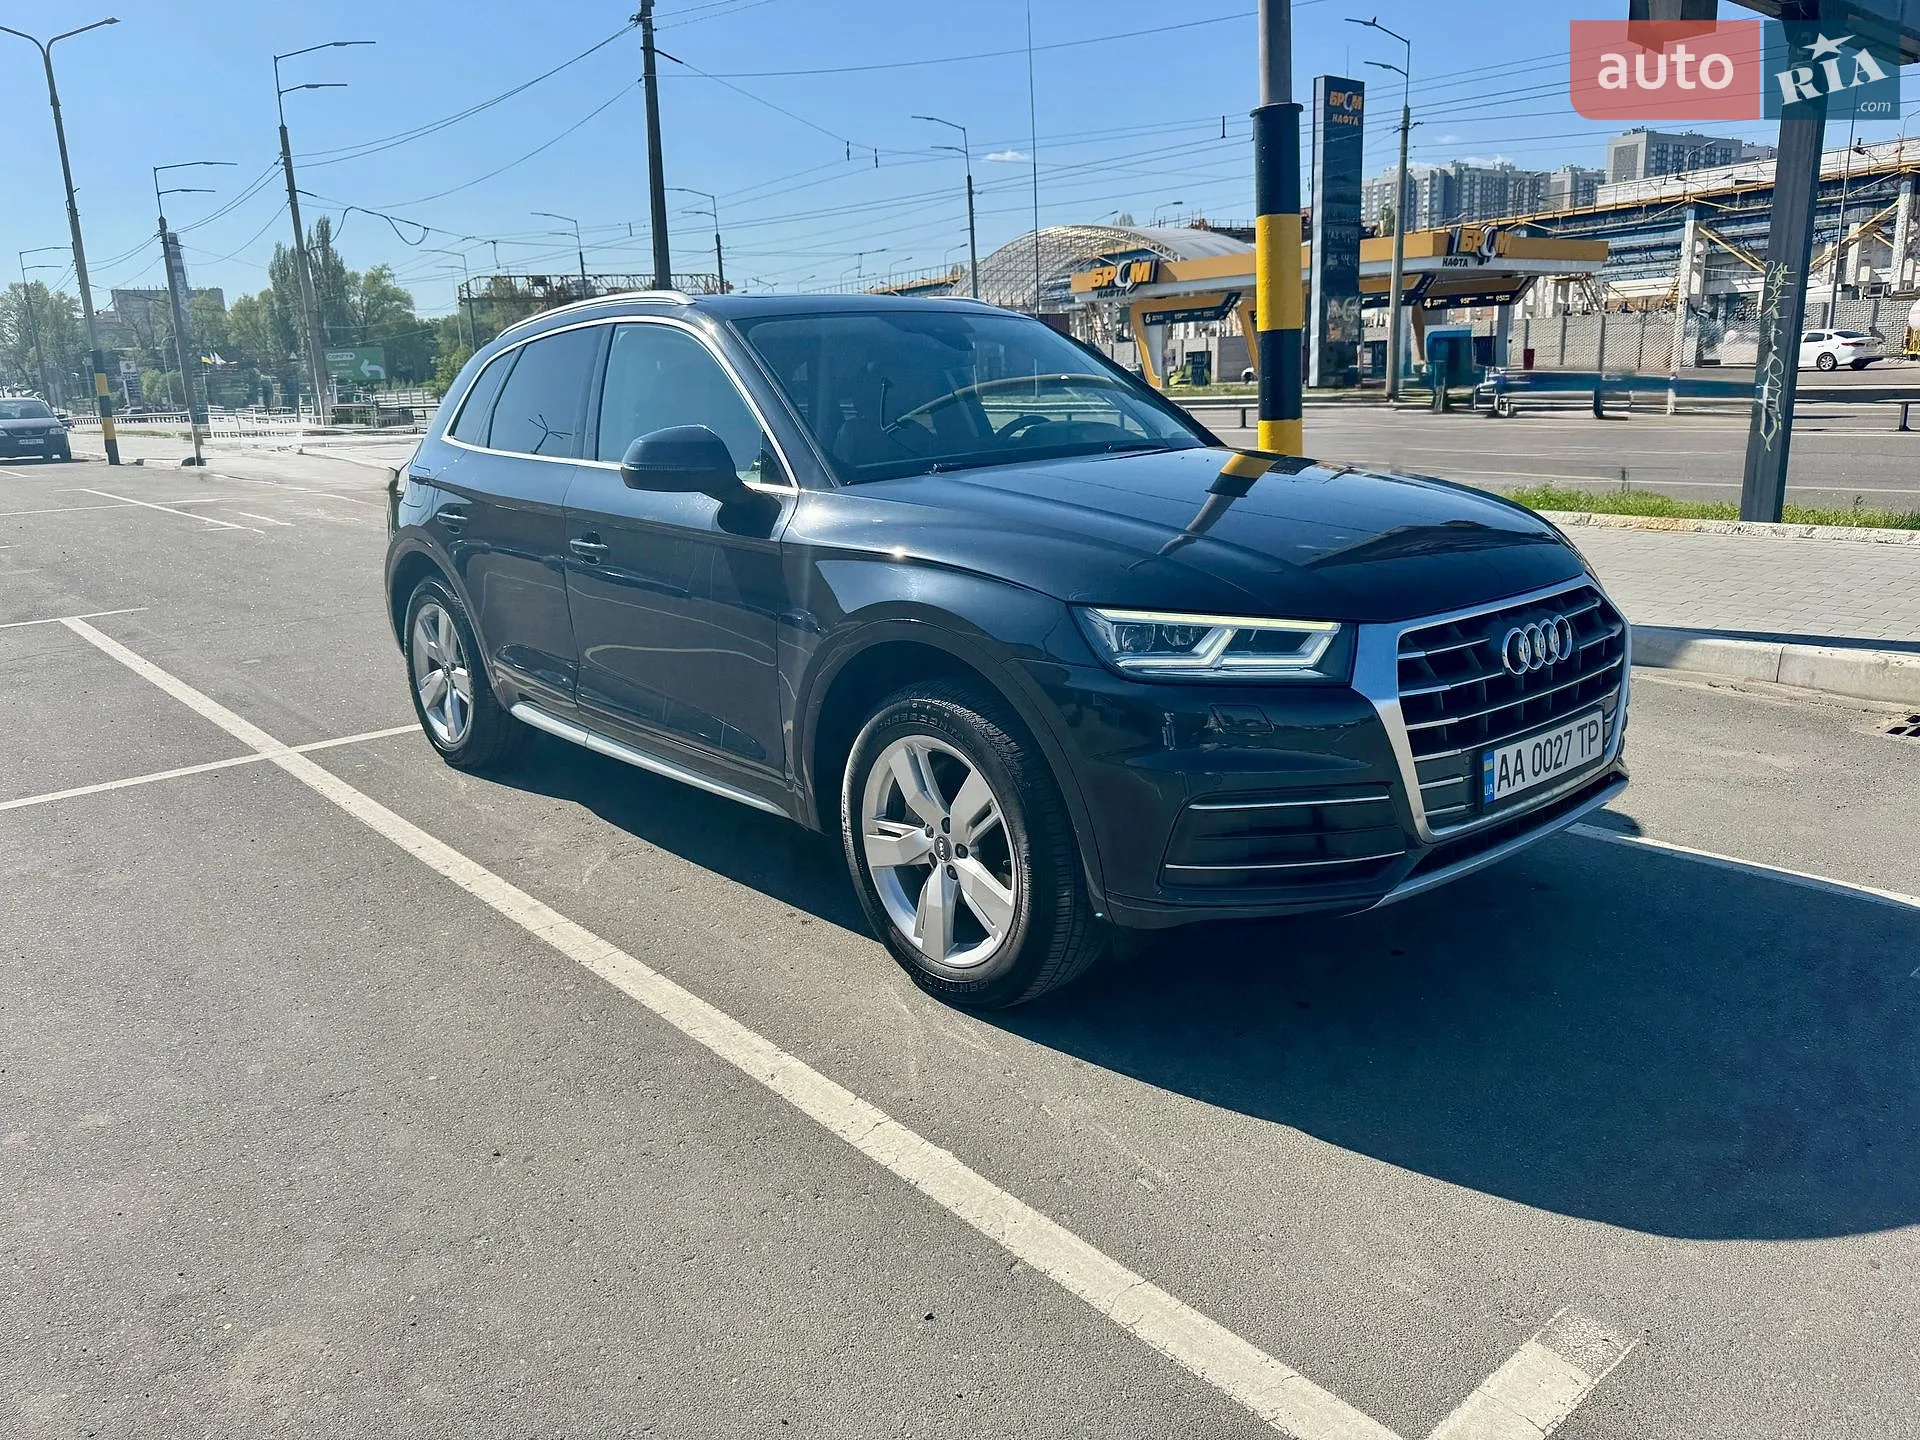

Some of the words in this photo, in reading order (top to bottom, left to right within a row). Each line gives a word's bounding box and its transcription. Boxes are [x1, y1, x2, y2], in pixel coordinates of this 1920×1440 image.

[1332, 113, 1360, 126] НАФТА
[1442, 257, 1469, 267] НАФТА
[1096, 289, 1127, 299] НАФТА
[1424, 298, 1432, 308] 4
[1145, 314, 1151, 323] 6
[1497, 749, 1526, 792] AA
[1531, 729, 1573, 777] 0027
[1577, 720, 1599, 758] TP
